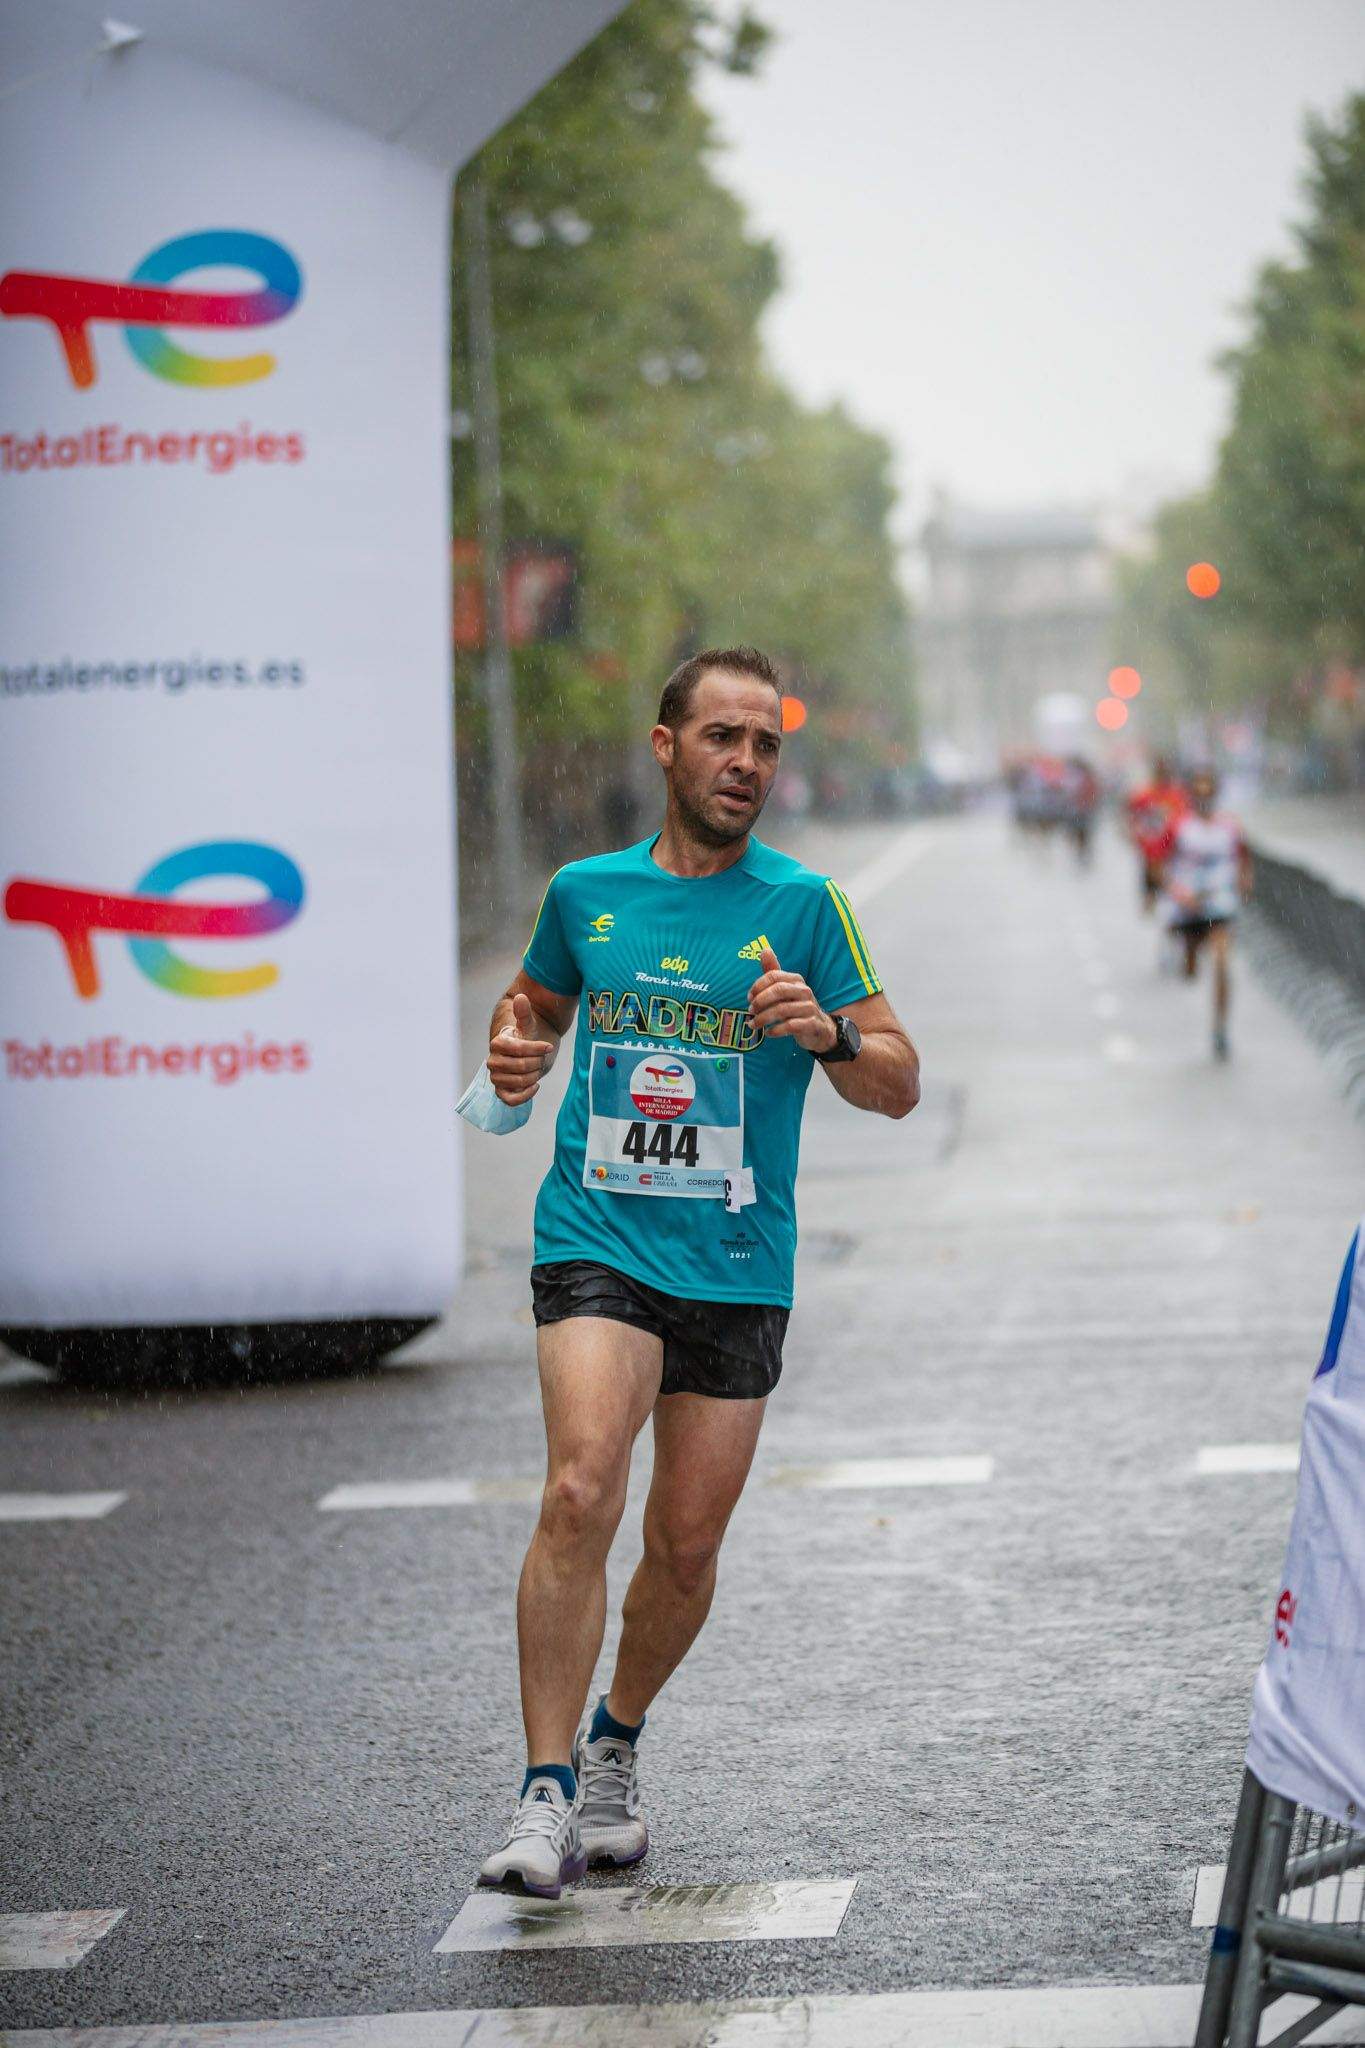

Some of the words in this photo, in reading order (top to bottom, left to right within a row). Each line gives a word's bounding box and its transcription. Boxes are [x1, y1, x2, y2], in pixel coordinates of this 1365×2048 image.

[660, 955, 689, 975] edp
[635, 972, 669, 986] Rock
[680, 979, 709, 992] Roll
[588, 991, 765, 1053] MADRID
[3, 1032, 310, 1085] TotalEnergies
[644, 1085, 684, 1094] TotalEnergies
[622, 1122, 700, 1167] 444
